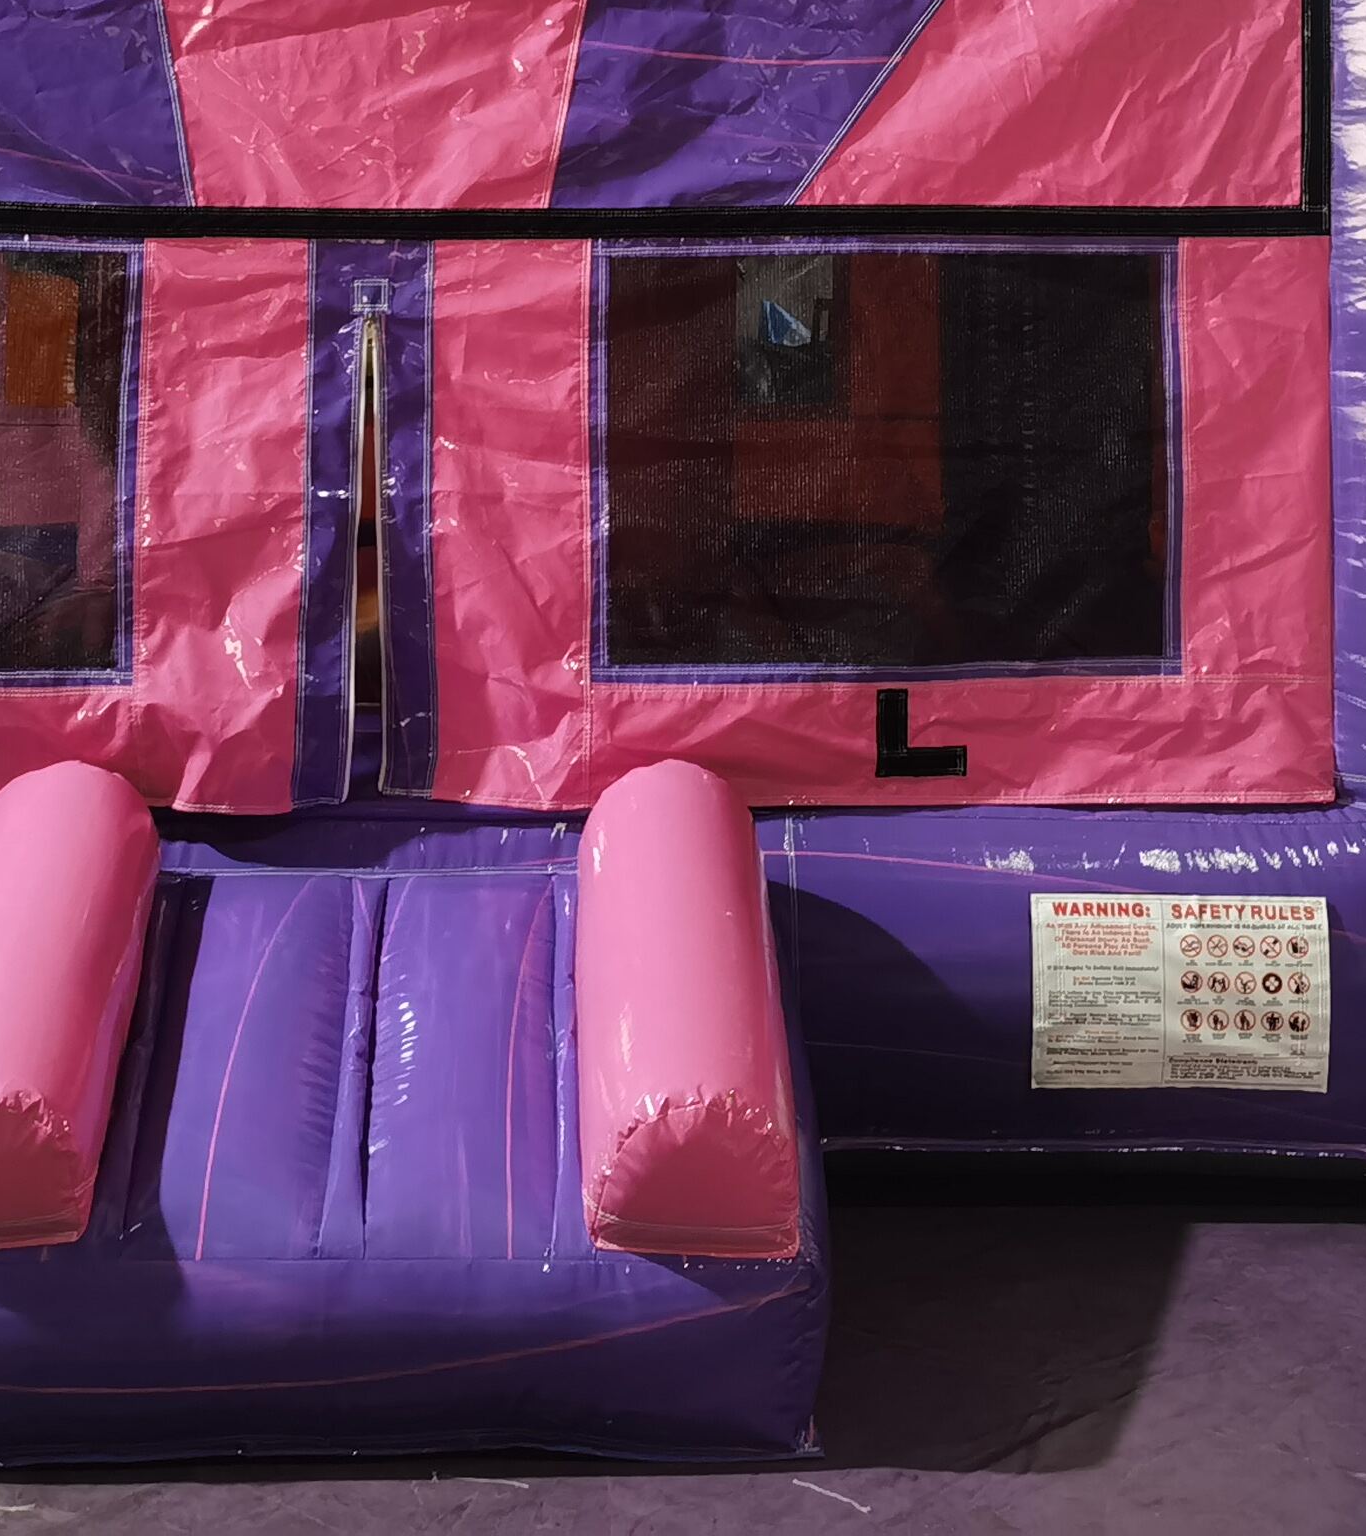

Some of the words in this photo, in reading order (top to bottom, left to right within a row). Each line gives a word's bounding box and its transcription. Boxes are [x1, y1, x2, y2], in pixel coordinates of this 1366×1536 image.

[1052, 902, 1151, 918] WARNING:
[1171, 903, 1246, 921] SAFETY
[1250, 905, 1315, 921] RULES
